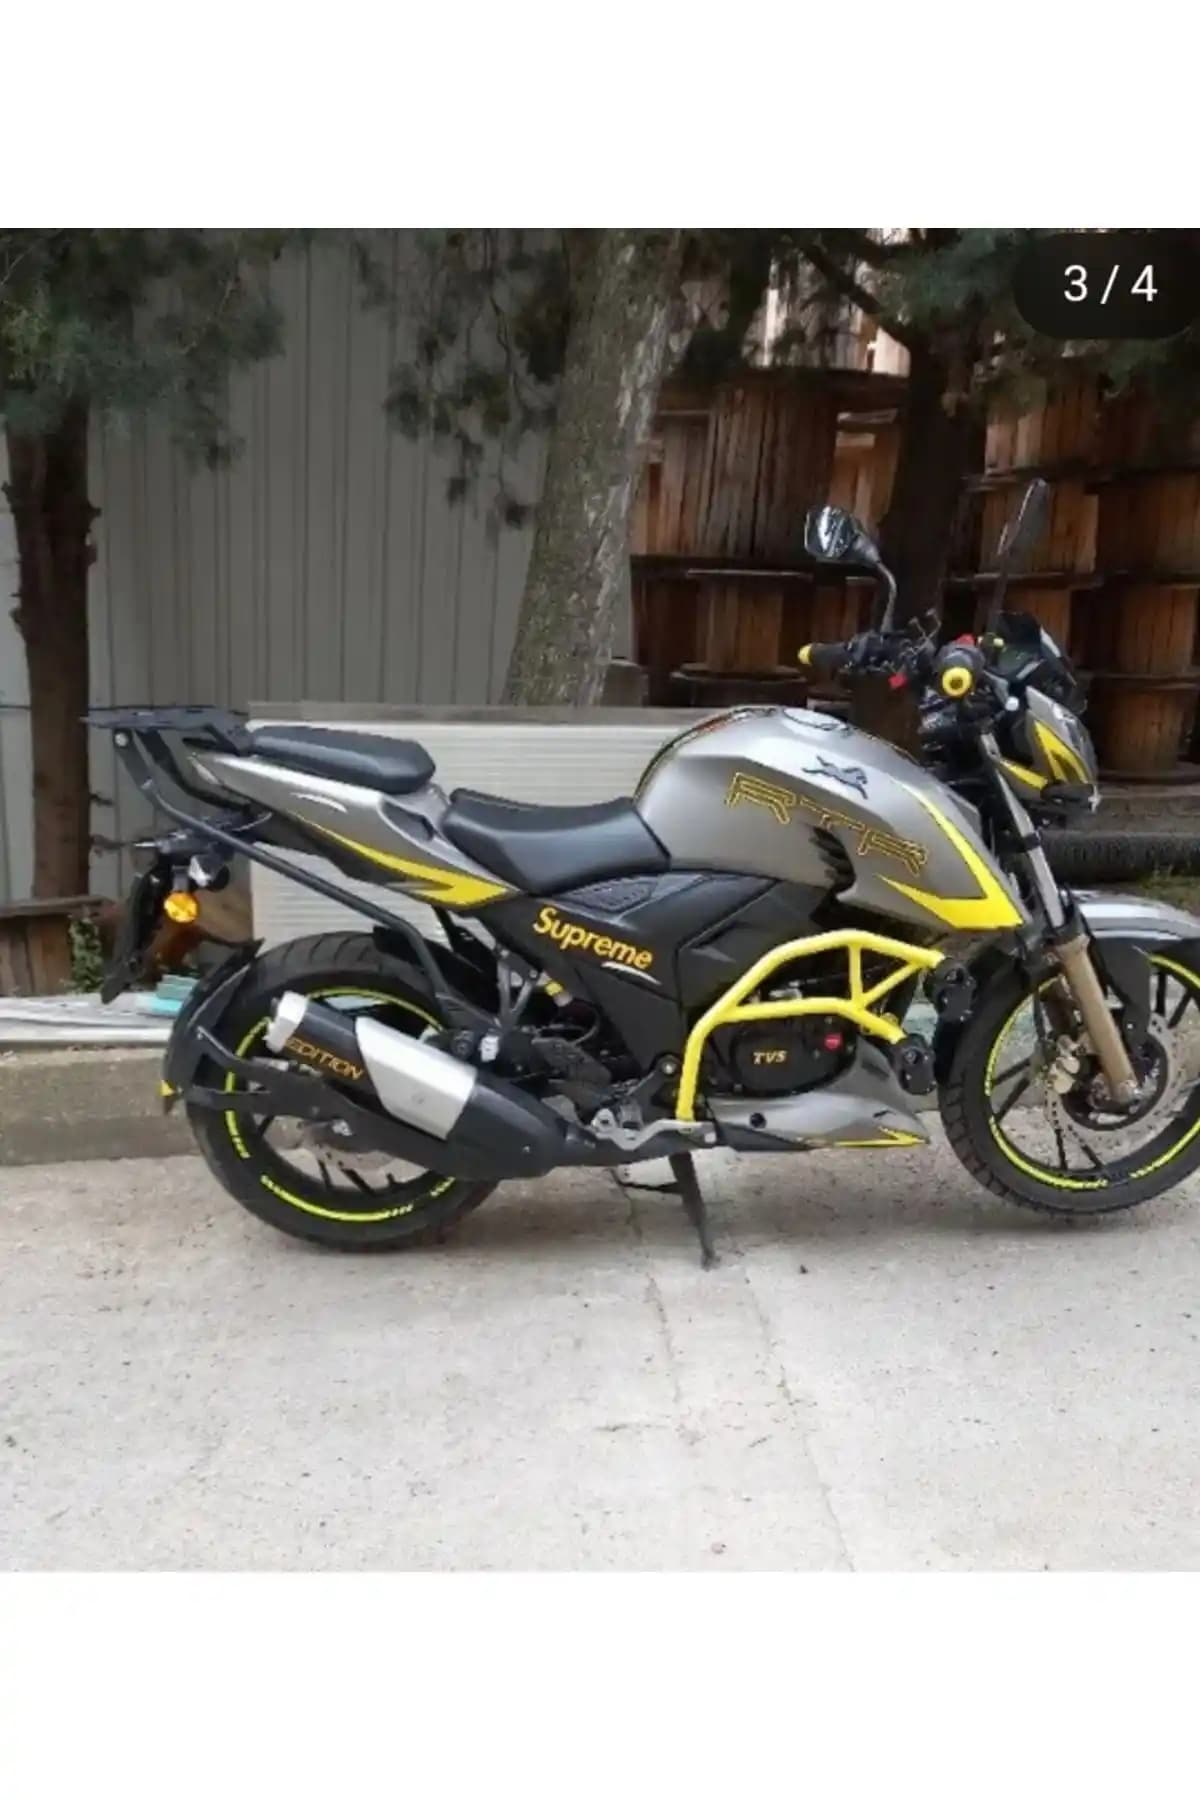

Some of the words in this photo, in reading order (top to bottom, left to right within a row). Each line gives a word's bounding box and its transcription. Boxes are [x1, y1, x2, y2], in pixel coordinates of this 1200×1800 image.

[725, 771, 928, 877] RTR
[532, 906, 653, 969] Supreme
[285, 1036, 365, 1080] EDITION
[752, 1050, 788, 1065] TVS
